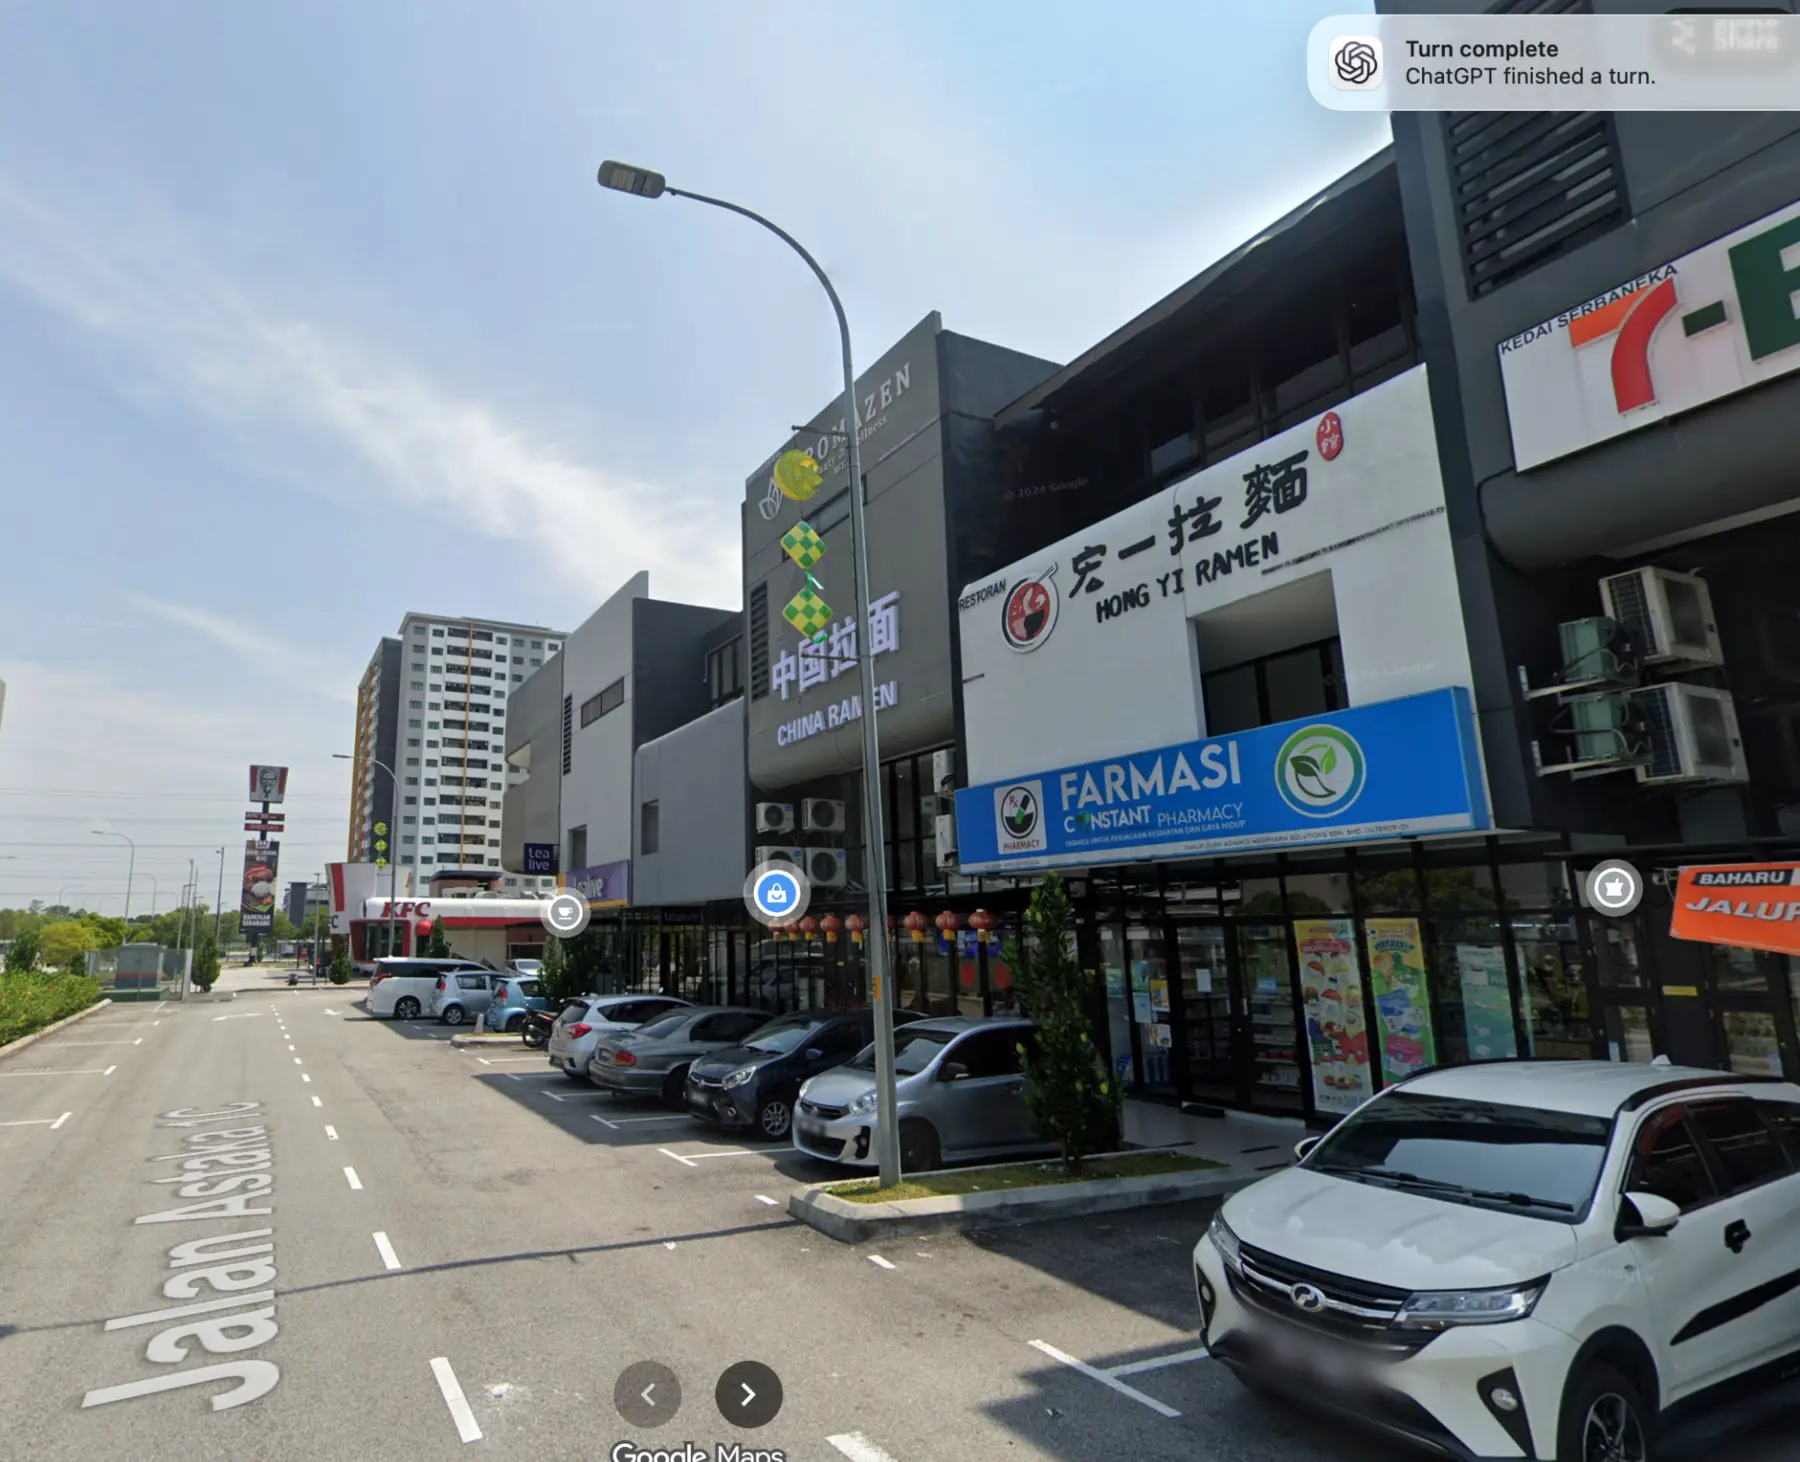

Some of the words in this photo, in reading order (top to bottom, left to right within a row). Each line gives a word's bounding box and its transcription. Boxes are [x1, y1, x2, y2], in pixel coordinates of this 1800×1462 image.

[1500, 323, 1554, 355] KEDAI
[1557, 264, 1679, 328] SERBANEKA
[1095, 582, 1150, 624] HONG
[1155, 567, 1186, 599] YI
[1195, 530, 1279, 586] RAMEN
[958, 578, 1008, 612] RESTORAN
[776, 708, 827, 747] CHINA
[1060, 740, 1243, 812] FARMASI
[1157, 801, 1244, 828] PHARMACY
[1185, 825, 1200, 835] DAN
[1201, 822, 1221, 834] GAYA
[1222, 819, 1246, 831] HIDUP
[528, 846, 550, 859] tea
[1003, 839, 1041, 853] PHARMACY
[528, 859, 551, 871] live
[1699, 871, 1785, 885] BAHARU
[380, 901, 431, 918] KFC
[134, 1124, 274, 1225] Astaka
[81, 1227, 280, 1412] Jalan
